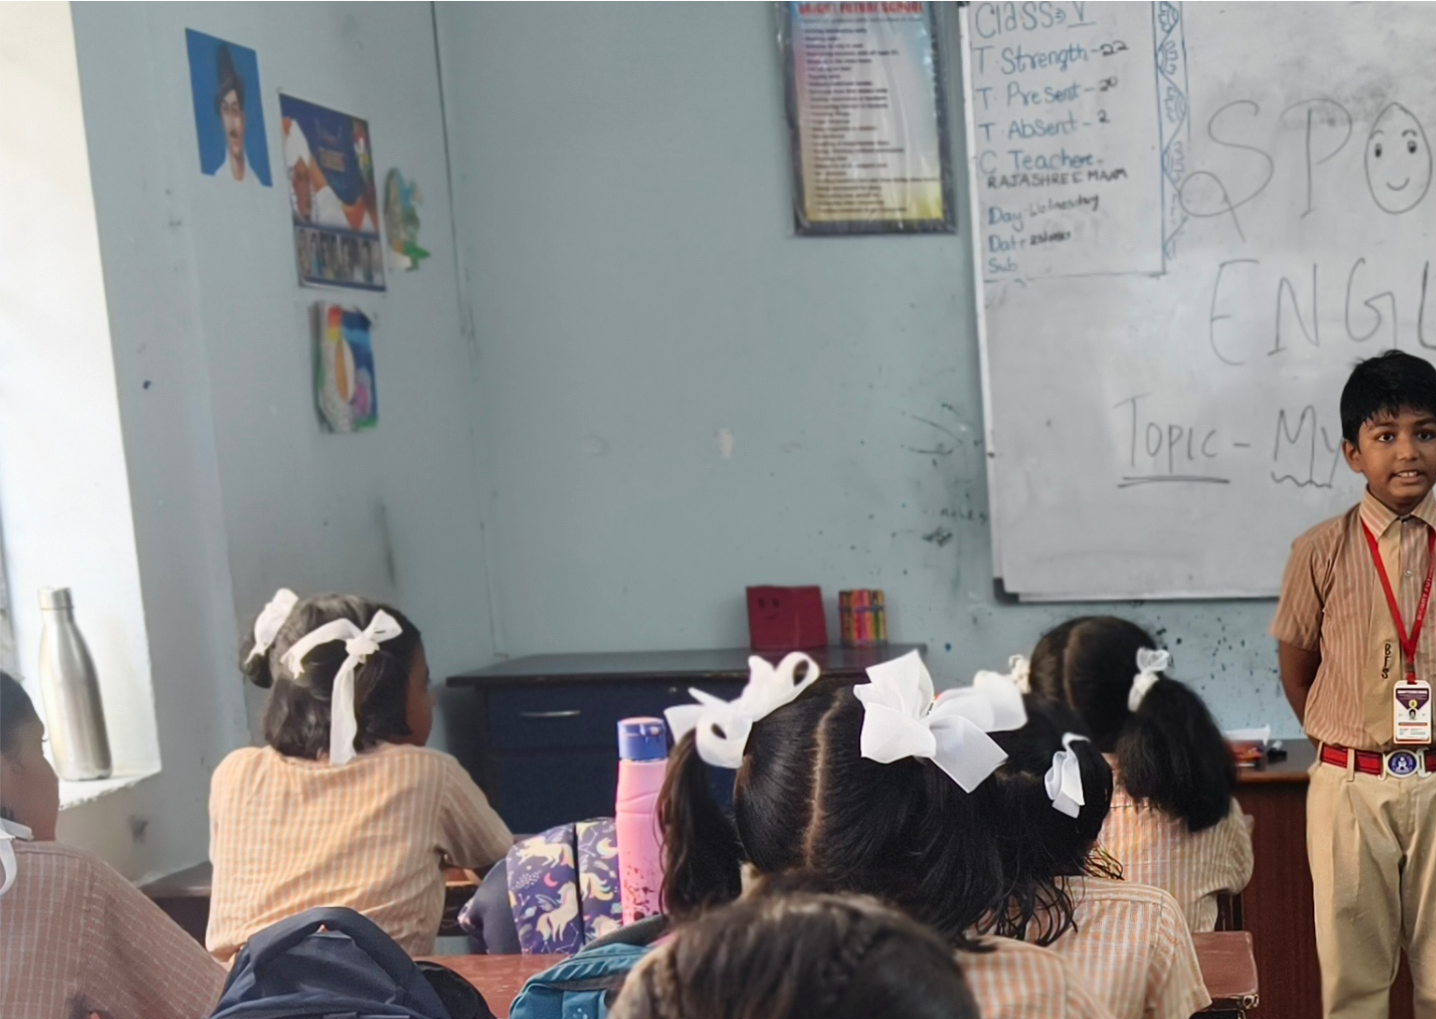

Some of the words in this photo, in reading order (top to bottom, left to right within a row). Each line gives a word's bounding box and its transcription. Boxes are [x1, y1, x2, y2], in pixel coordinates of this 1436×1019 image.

[1001, 44, 1089, 75] Strength
[987, 172, 1083, 190] RAJASHREE
[988, 257, 1017, 274] Sub
